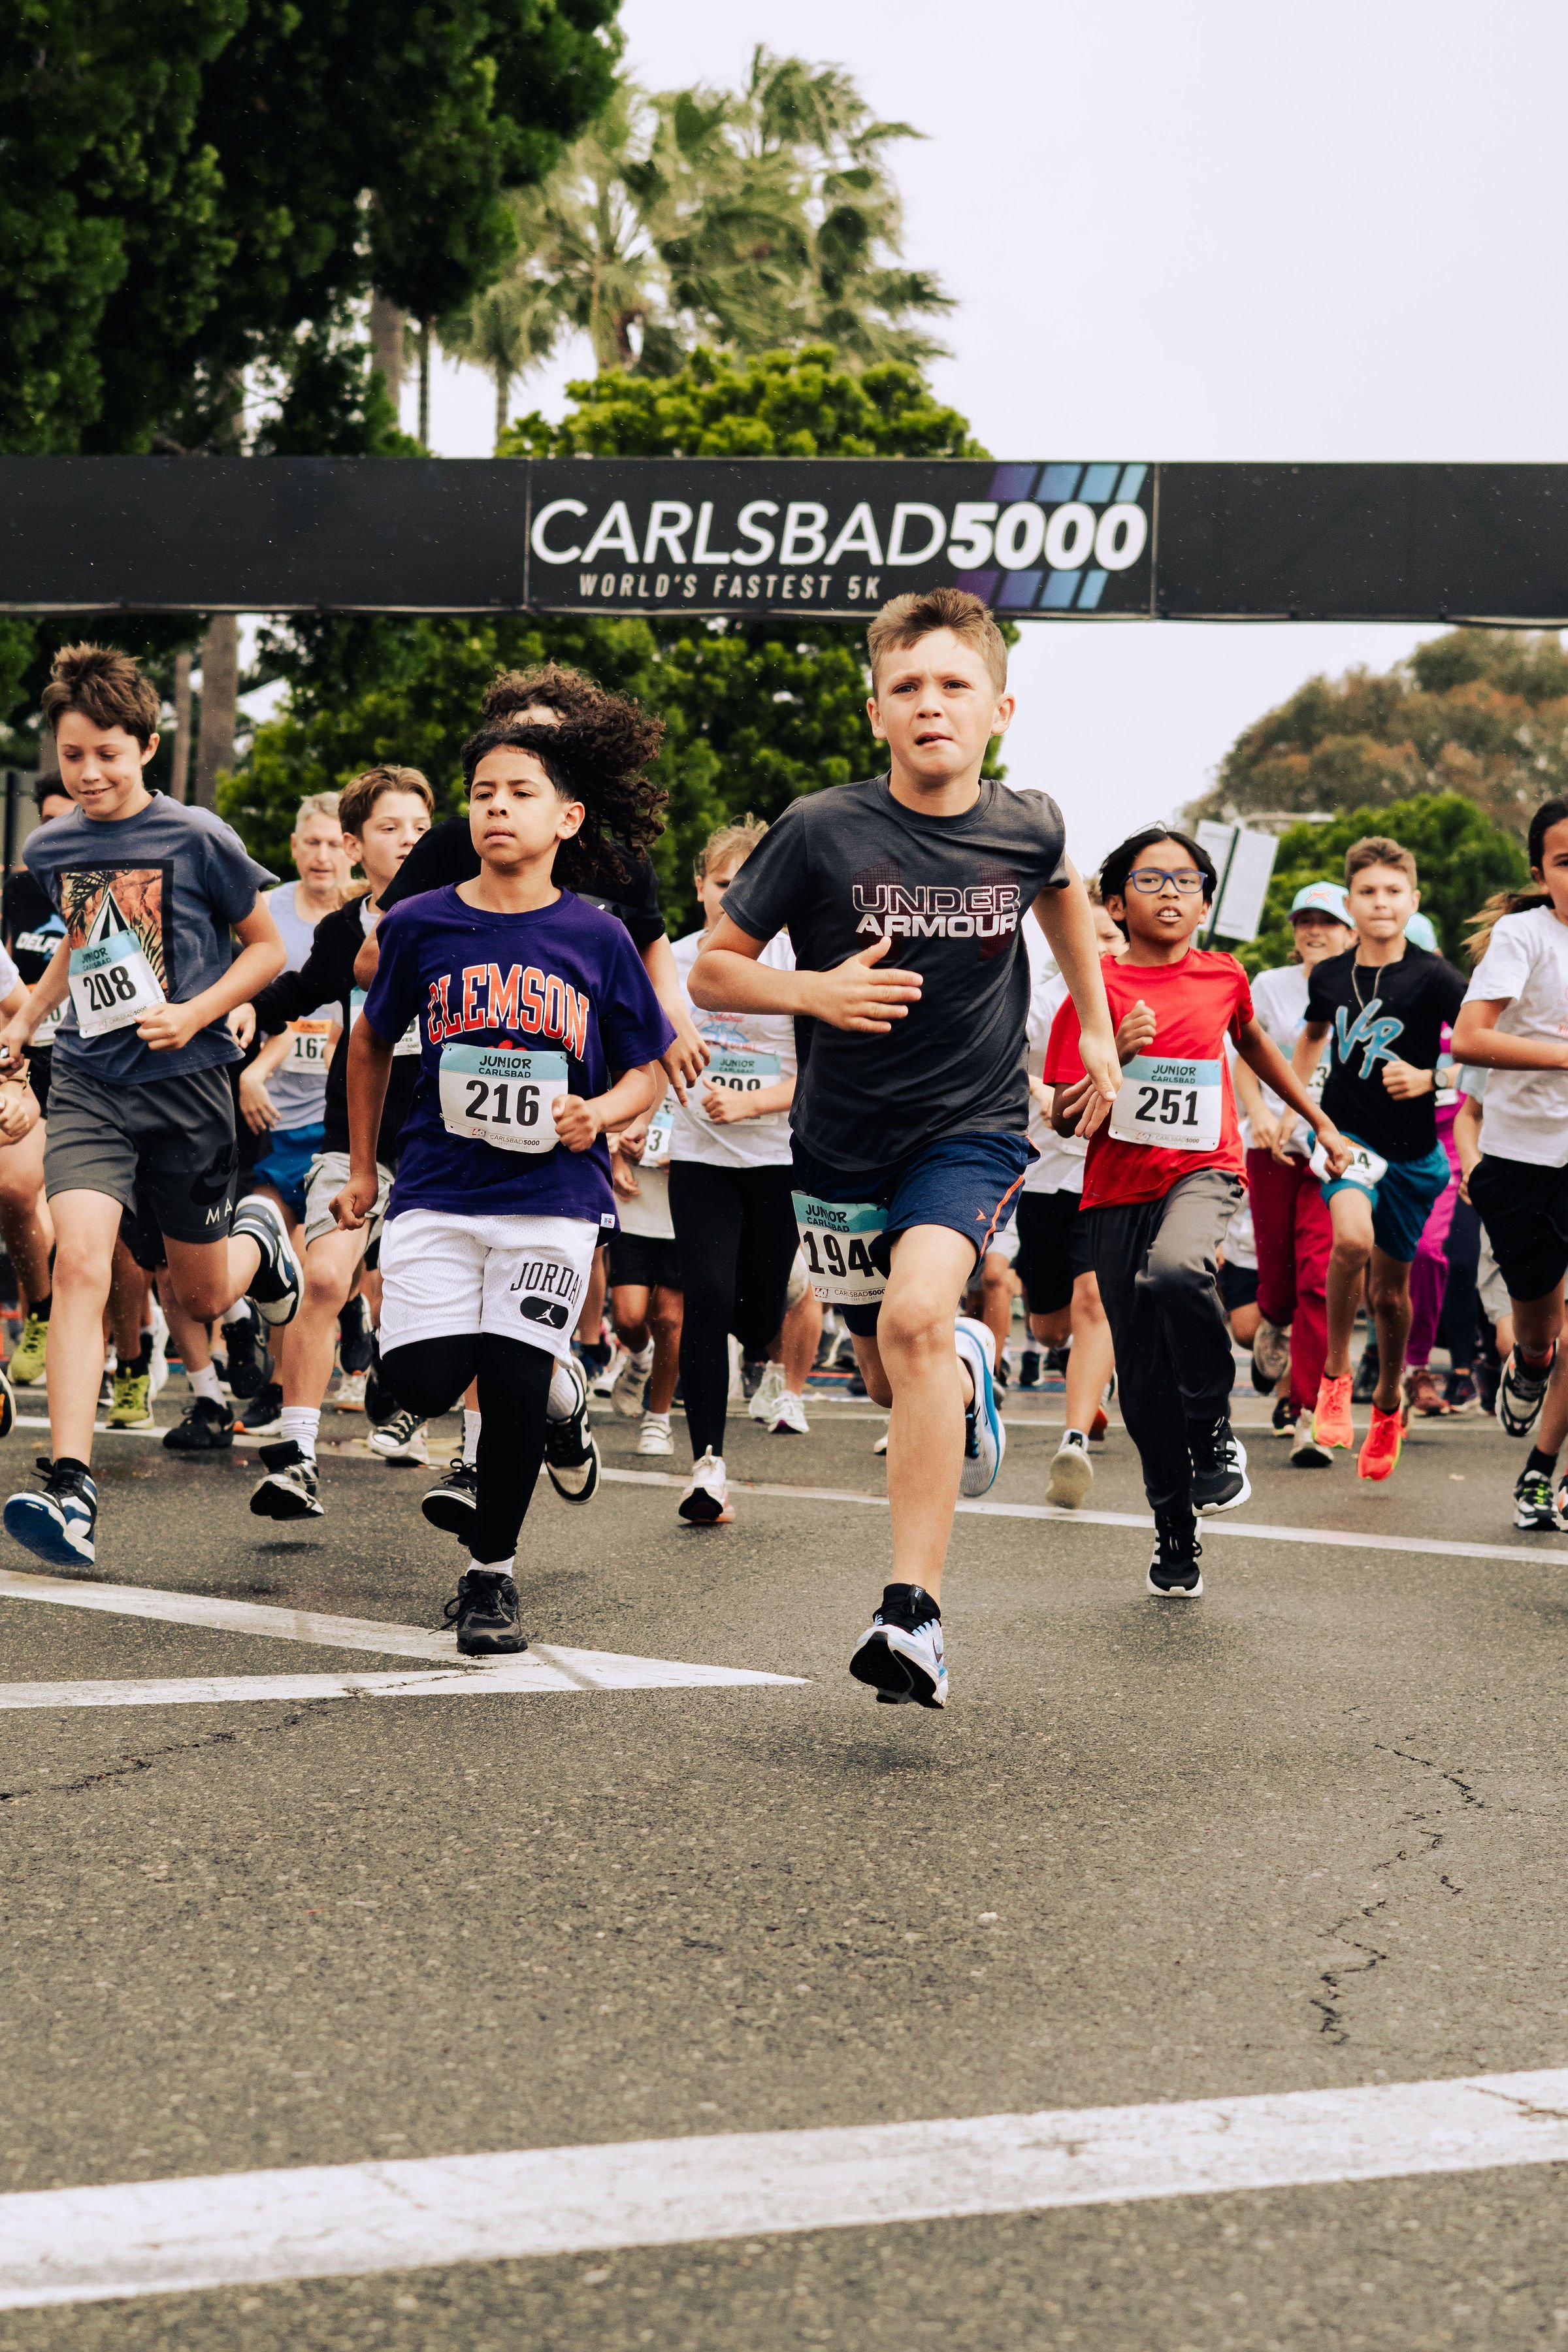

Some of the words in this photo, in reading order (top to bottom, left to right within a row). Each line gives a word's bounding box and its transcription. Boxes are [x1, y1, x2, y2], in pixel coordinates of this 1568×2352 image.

[531, 500, 1148, 571] CARLSBAD5000
[579, 574, 698, 598] WORLD'S
[713, 574, 832, 599] FASTEST
[847, 576, 881, 600] 5K
[853, 885, 1021, 915] UNDER
[856, 913, 1018, 938] ARMOUR
[82, 947, 108, 964] JUNIOR
[83, 966, 137, 1011] 208
[427, 963, 589, 1061] CLEMSON
[1335, 998, 1404, 1079] VR
[478, 1068, 531, 1078] CARLSBAD
[479, 1055, 532, 1070] JUNIOR
[720, 1058, 755, 1068] JUNIOR
[1152, 1064, 1196, 1076] JUNIOR
[1151, 1075, 1196, 1084] CARLSBAD
[465, 1080, 540, 1126] 216
[1135, 1086, 1198, 1125] 251
[490, 1134, 540, 1146] CARLSBAD5000
[806, 1203, 847, 1224] JUNIOR
[807, 1217, 850, 1233] CARLSBAD
[803, 1230, 876, 1278] 194
